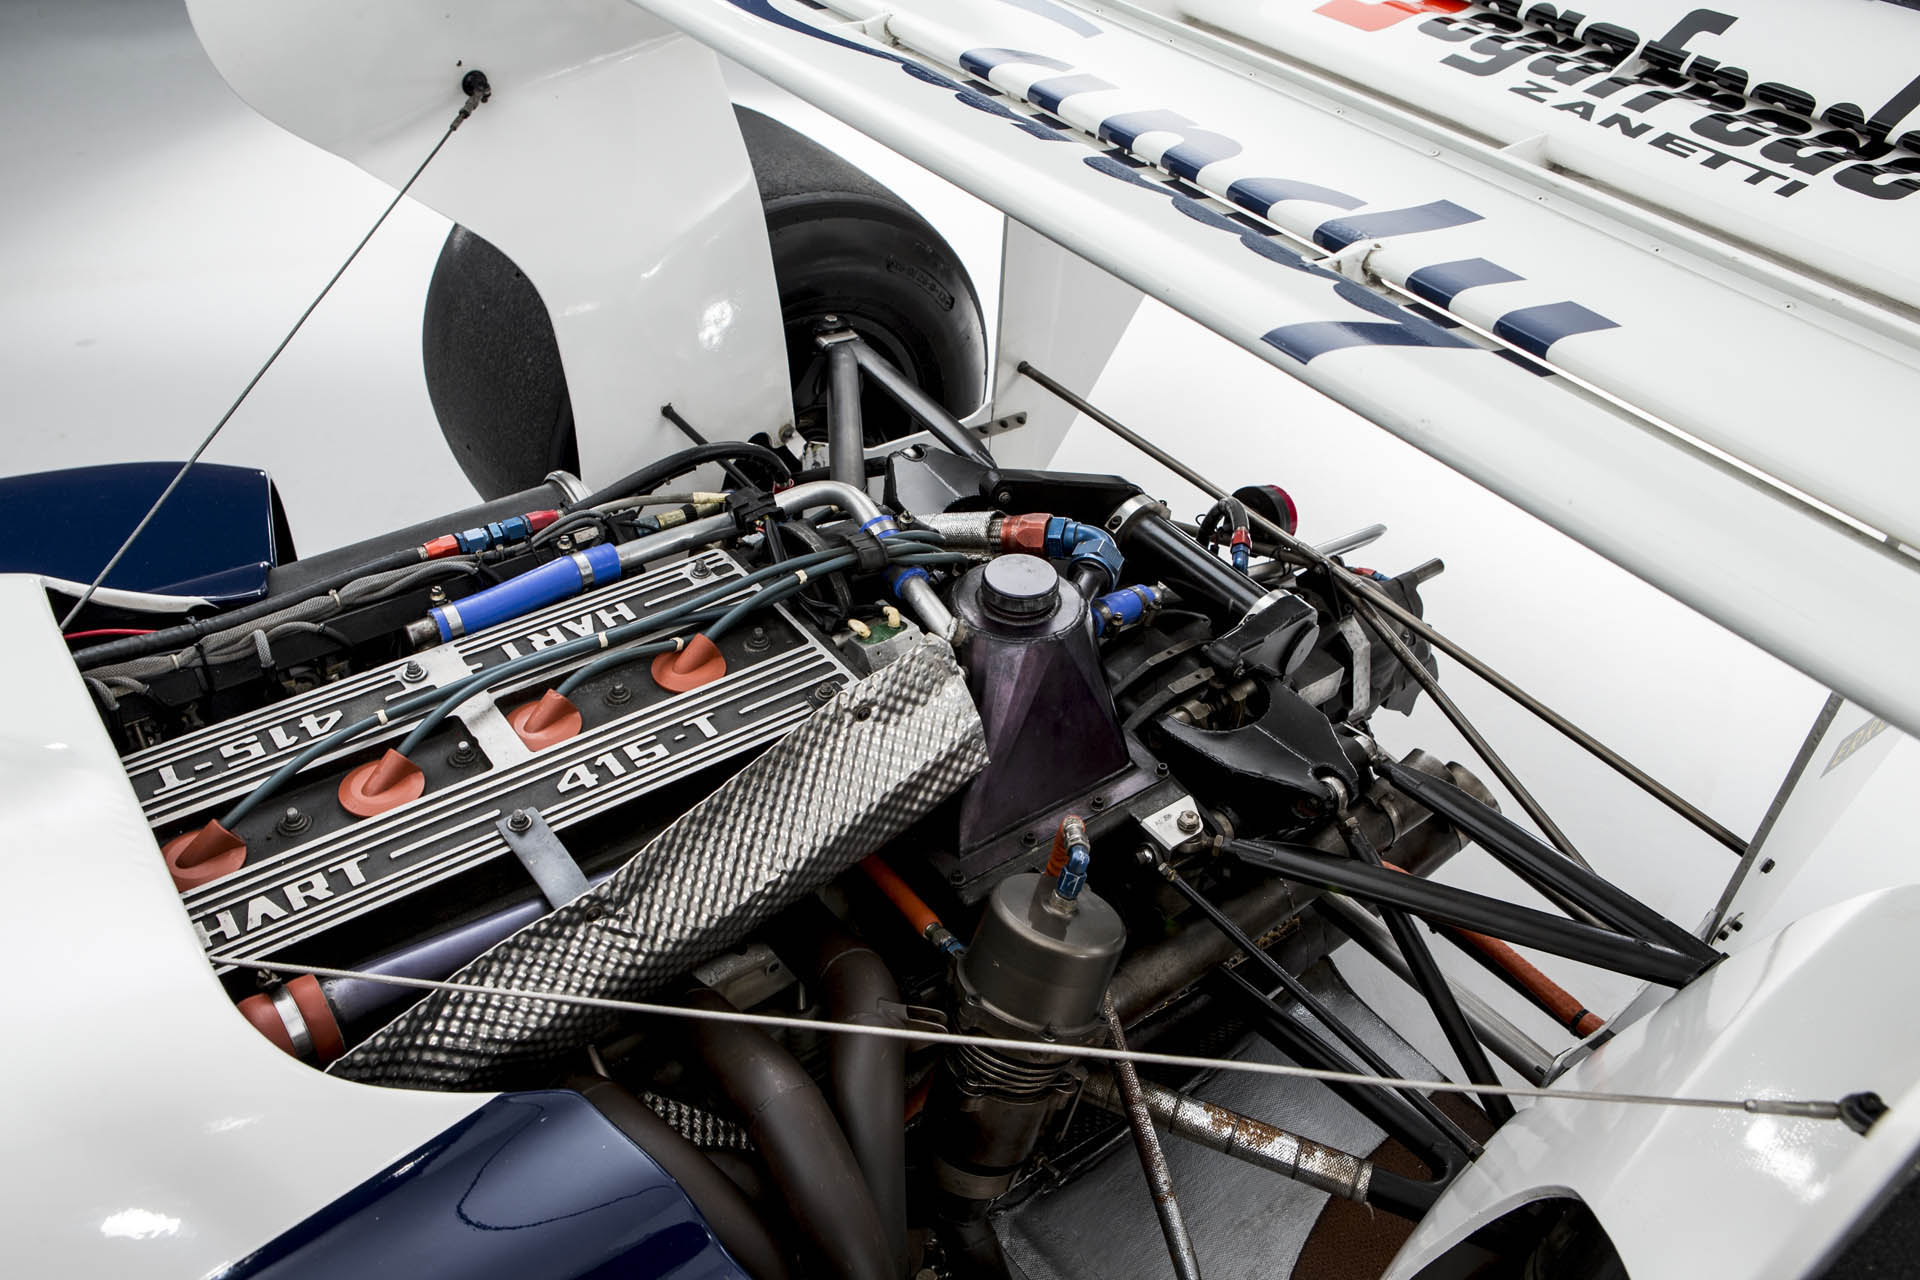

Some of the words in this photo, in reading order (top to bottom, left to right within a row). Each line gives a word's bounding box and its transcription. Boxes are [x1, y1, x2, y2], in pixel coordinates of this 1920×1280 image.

[1508, 80, 1809, 198] ZANETTI
[153, 708, 344, 795] 415-T
[194, 852, 370, 948] HART
[556, 712, 725, 794] 415-T
